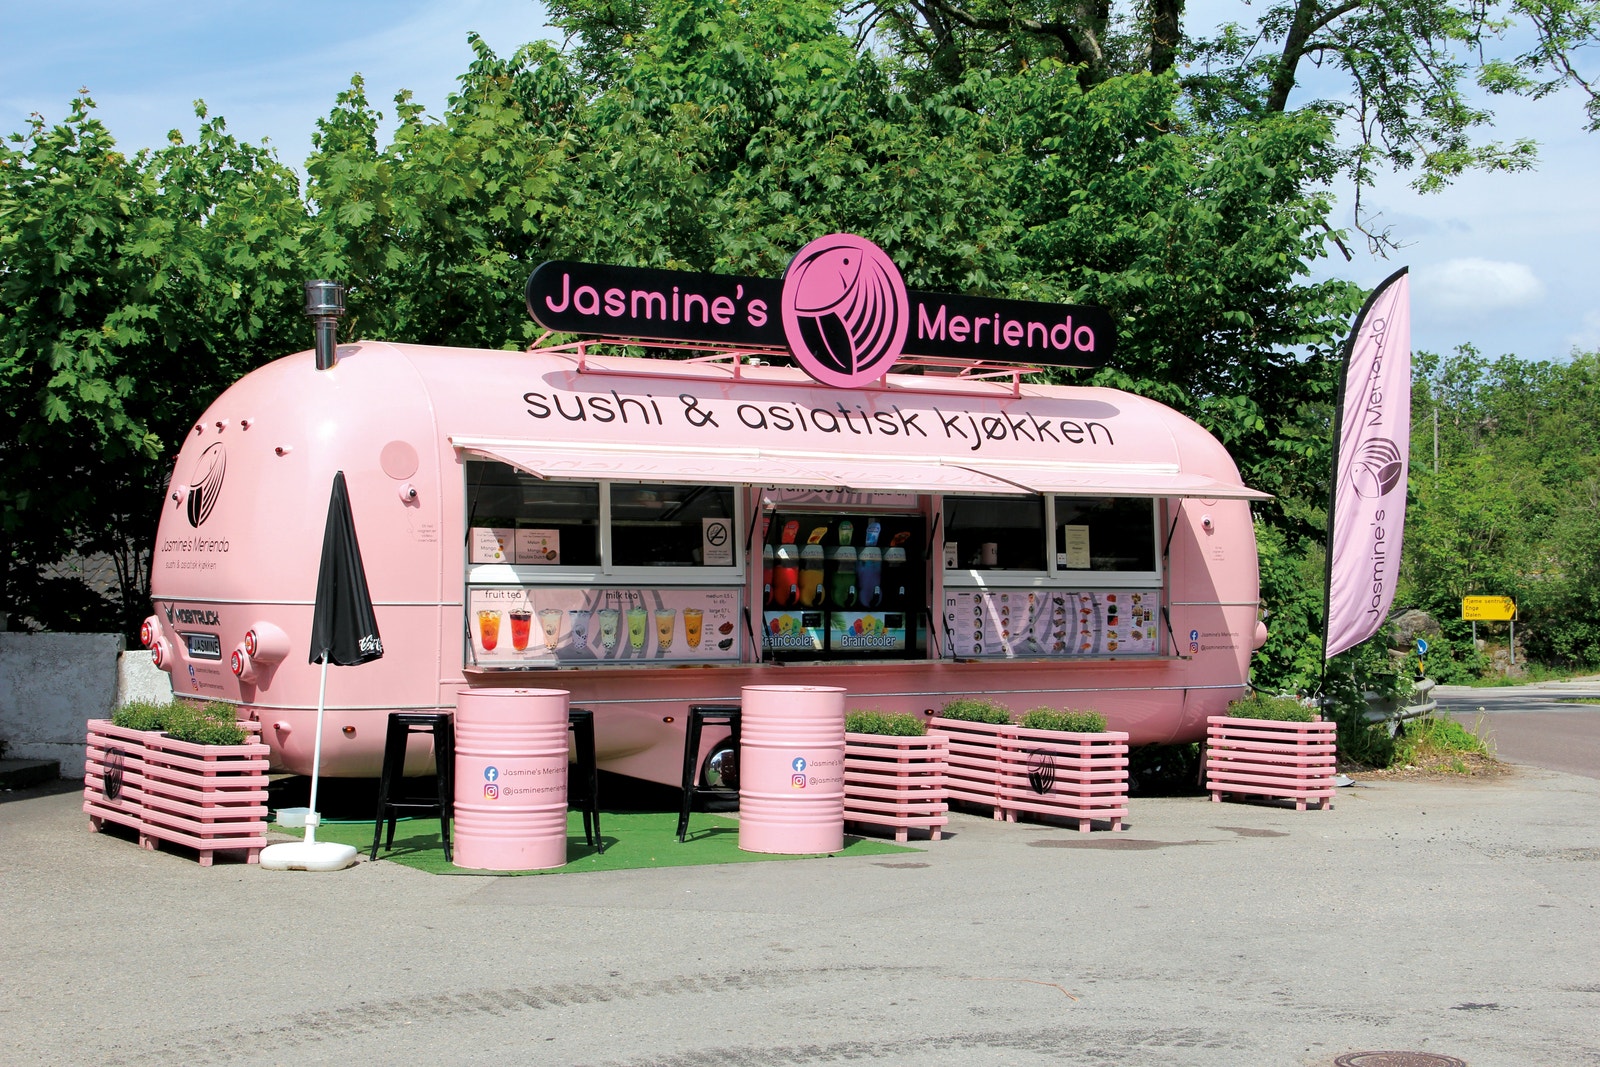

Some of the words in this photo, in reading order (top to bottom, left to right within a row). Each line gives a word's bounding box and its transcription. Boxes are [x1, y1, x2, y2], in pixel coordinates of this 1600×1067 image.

[545, 273, 768, 328] Jasmine's
[917, 304, 1095, 353] Merienda
[523, 391, 664, 426] sushi
[684, 393, 719, 429] &
[737, 400, 928, 437] asiatisk
[936, 406, 1114, 451] kjøkken
[161, 536, 193, 552] Jasmine's
[193, 536, 230, 553] Merienda
[1367, 509, 1386, 621] Jasmine's
[485, 590, 505, 599] fruit
[507, 591, 522, 599] tea
[605, 591, 623, 600] milk
[624, 591, 638, 600] tea
[193, 639, 219, 654] JASMINE
[762, 634, 814, 647] rainCooler
[841, 635, 896, 647] BrainCooler
[502, 768, 542, 776] Jasmine's
